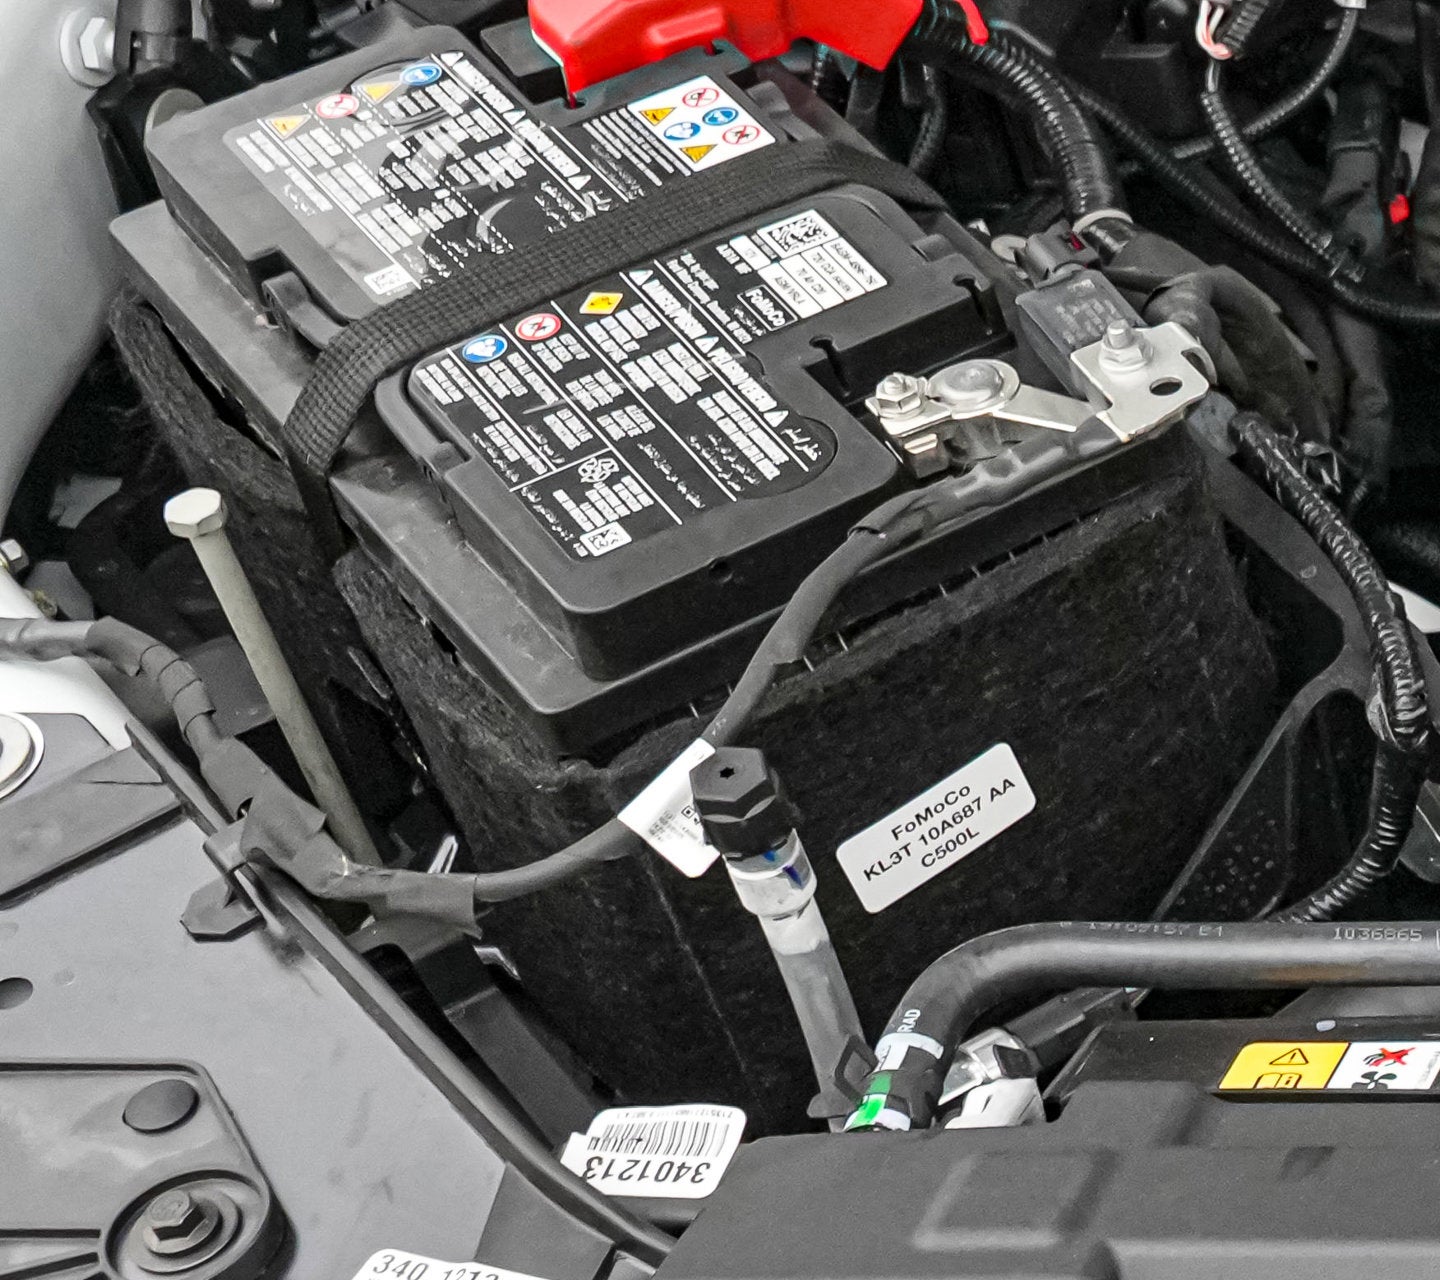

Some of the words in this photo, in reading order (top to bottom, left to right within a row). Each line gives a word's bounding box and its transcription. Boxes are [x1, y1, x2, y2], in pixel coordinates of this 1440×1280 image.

[745, 287, 786, 327] FoMoCo
[863, 842, 912, 882] KL3T
[918, 796, 982, 847] 10A687
[988, 778, 1016, 802] AA
[891, 784, 971, 841] FoMoCo
[920, 826, 980, 869] C500L
[1333, 927, 1423, 941] 1036865
[896, 1008, 921, 1033] RAD
[582, 1156, 711, 1184] 3401213
